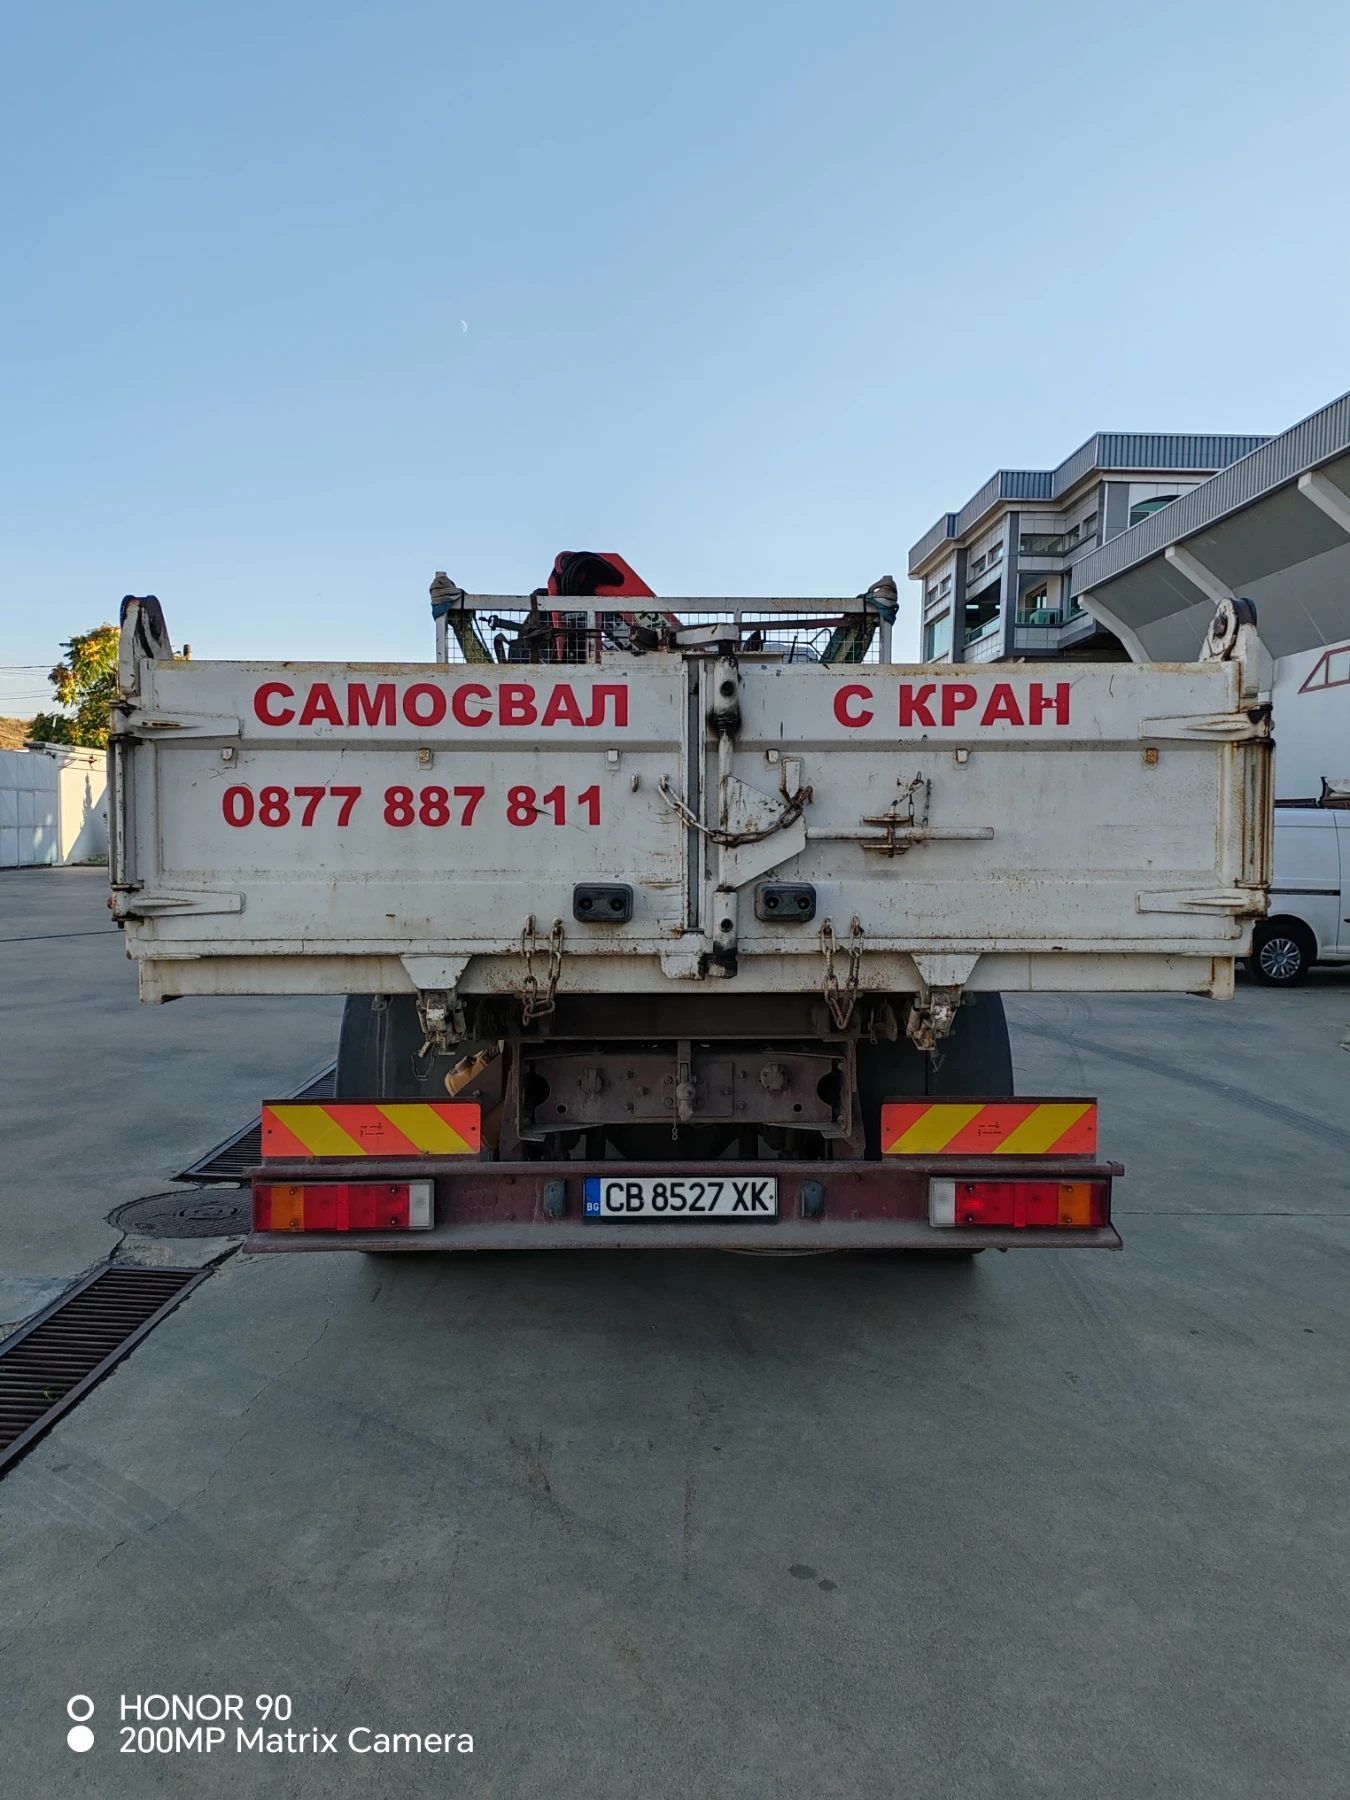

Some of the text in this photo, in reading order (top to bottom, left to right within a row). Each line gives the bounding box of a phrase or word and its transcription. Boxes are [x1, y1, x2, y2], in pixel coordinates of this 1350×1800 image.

[254, 682, 1071, 728] САМОСВАЛ С КРАН
[223, 785, 601, 827] 0877 887 811
[586, 1202, 599, 1212] BG
[651, 1182, 724, 1212] 8527
